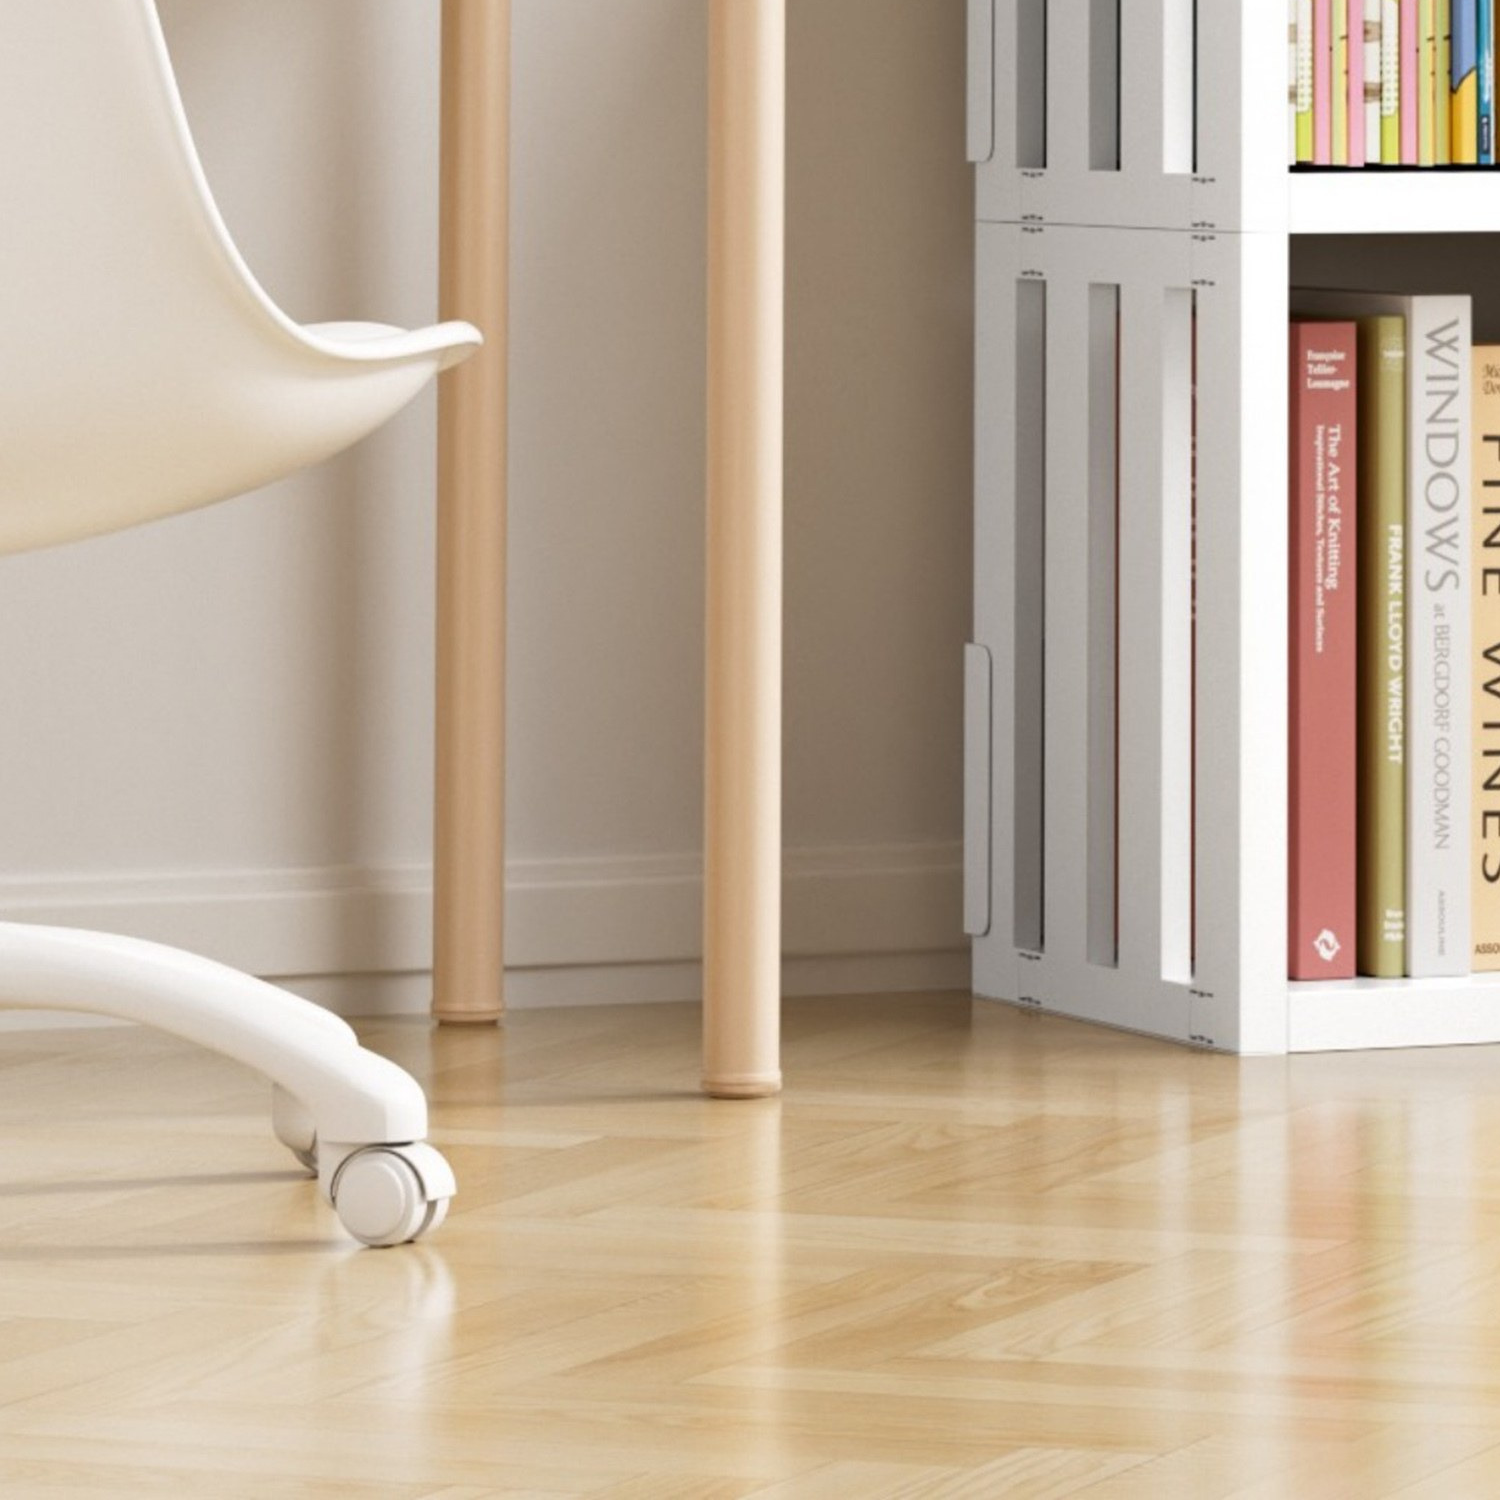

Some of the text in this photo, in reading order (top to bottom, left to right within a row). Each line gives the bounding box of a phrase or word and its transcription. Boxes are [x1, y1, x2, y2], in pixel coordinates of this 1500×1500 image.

[1315, 586, 1324, 606] and
[1325, 424, 1341, 590] The Art of Knitting
[1424, 318, 1460, 850] WINDOWS at BERGDORF GOODMAN
[1388, 523, 1403, 765] FRANK LLOYD WRIGHT
